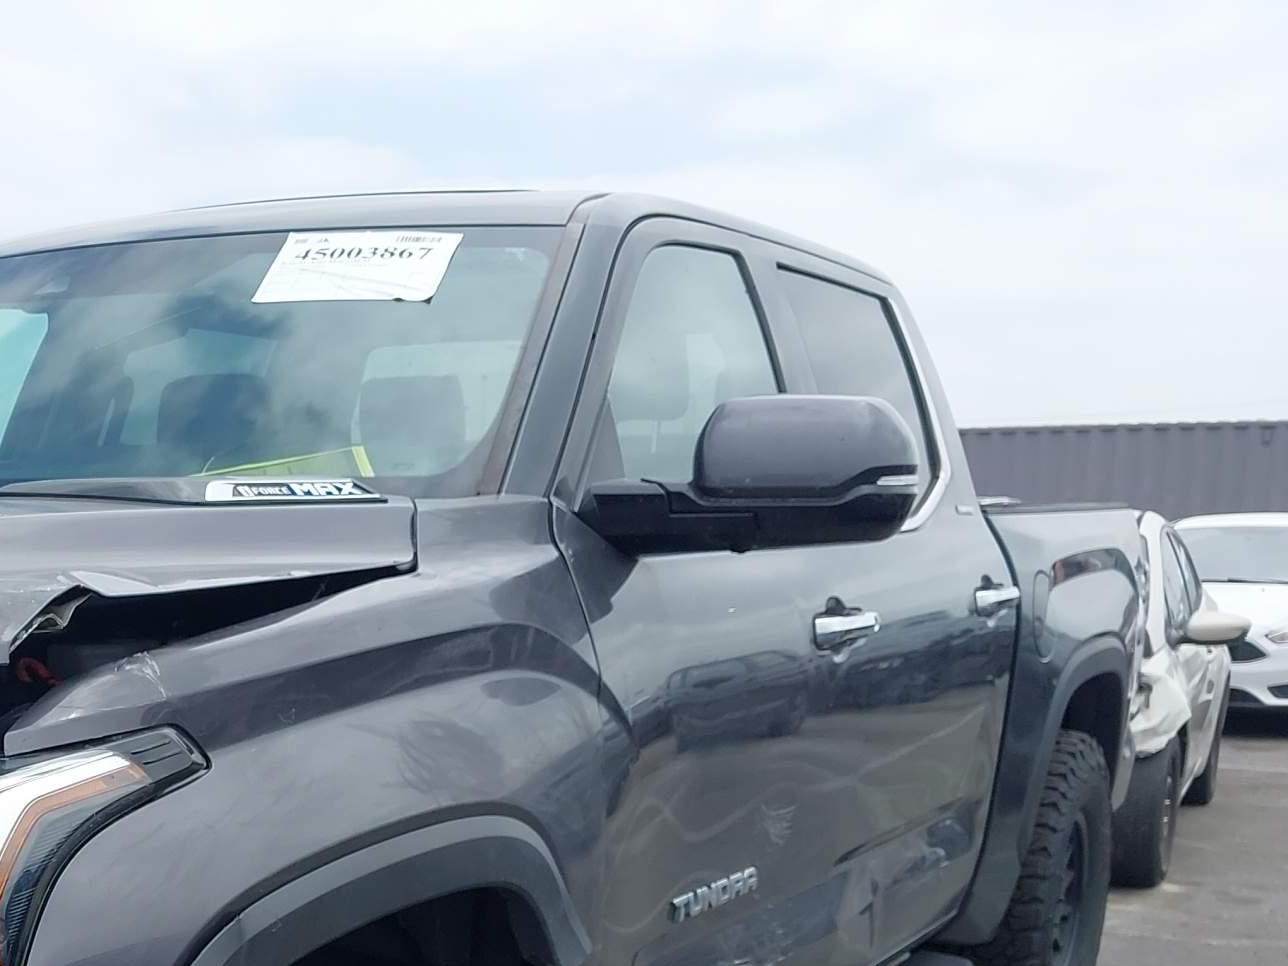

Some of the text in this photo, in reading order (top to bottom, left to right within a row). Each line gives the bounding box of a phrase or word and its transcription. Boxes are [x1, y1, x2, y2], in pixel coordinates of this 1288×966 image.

[294, 246, 435, 261] 45003867
[291, 482, 363, 496] MAX
[669, 865, 758, 922] TUNDRA
